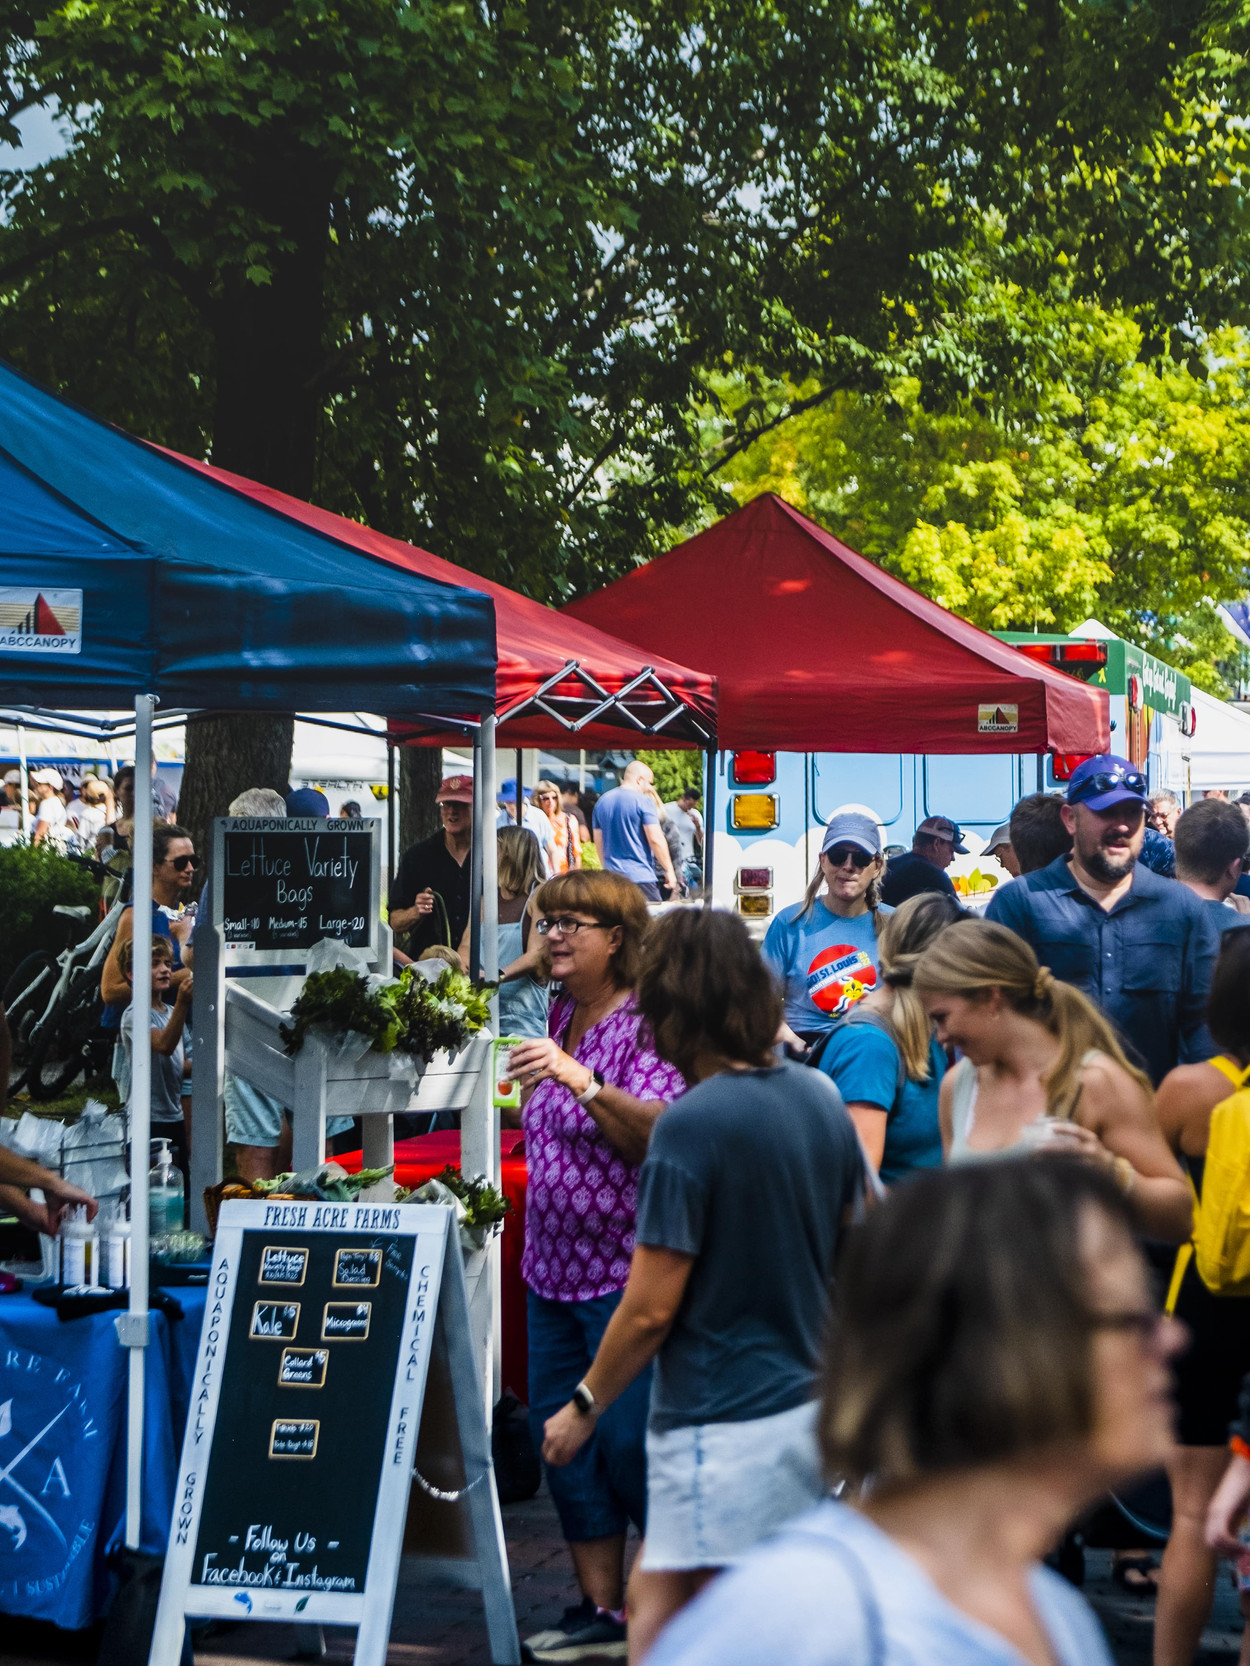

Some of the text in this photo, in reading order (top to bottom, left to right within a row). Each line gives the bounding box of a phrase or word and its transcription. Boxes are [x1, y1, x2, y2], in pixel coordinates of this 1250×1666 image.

[0, 636, 77, 648] ABCCANOPY
[231, 819, 364, 831] AQUAPONICALLY GROWN
[226, 836, 359, 889] Lettuce Variety
[276, 879, 314, 911] Bags
[830, 955, 858, 973] Louis
[263, 1205, 401, 1230] FRESH ACRE FARMS
[266, 1249, 305, 1263] Lettuce
[338, 1262, 366, 1276] Salad
[253, 1304, 283, 1336] Kale
[284, 1355, 314, 1368] Collard
[393, 1265, 430, 1464] CHEMICAL FREE
[282, 1367, 313, 1381] Greens
[176, 1257, 230, 1545] AQUAPONICALLY GROWN
[244, 1524, 289, 1551] Follow
[293, 1531, 317, 1553] Us
[269, 1551, 288, 1564] on
[282, 1562, 356, 1591] Instagram
